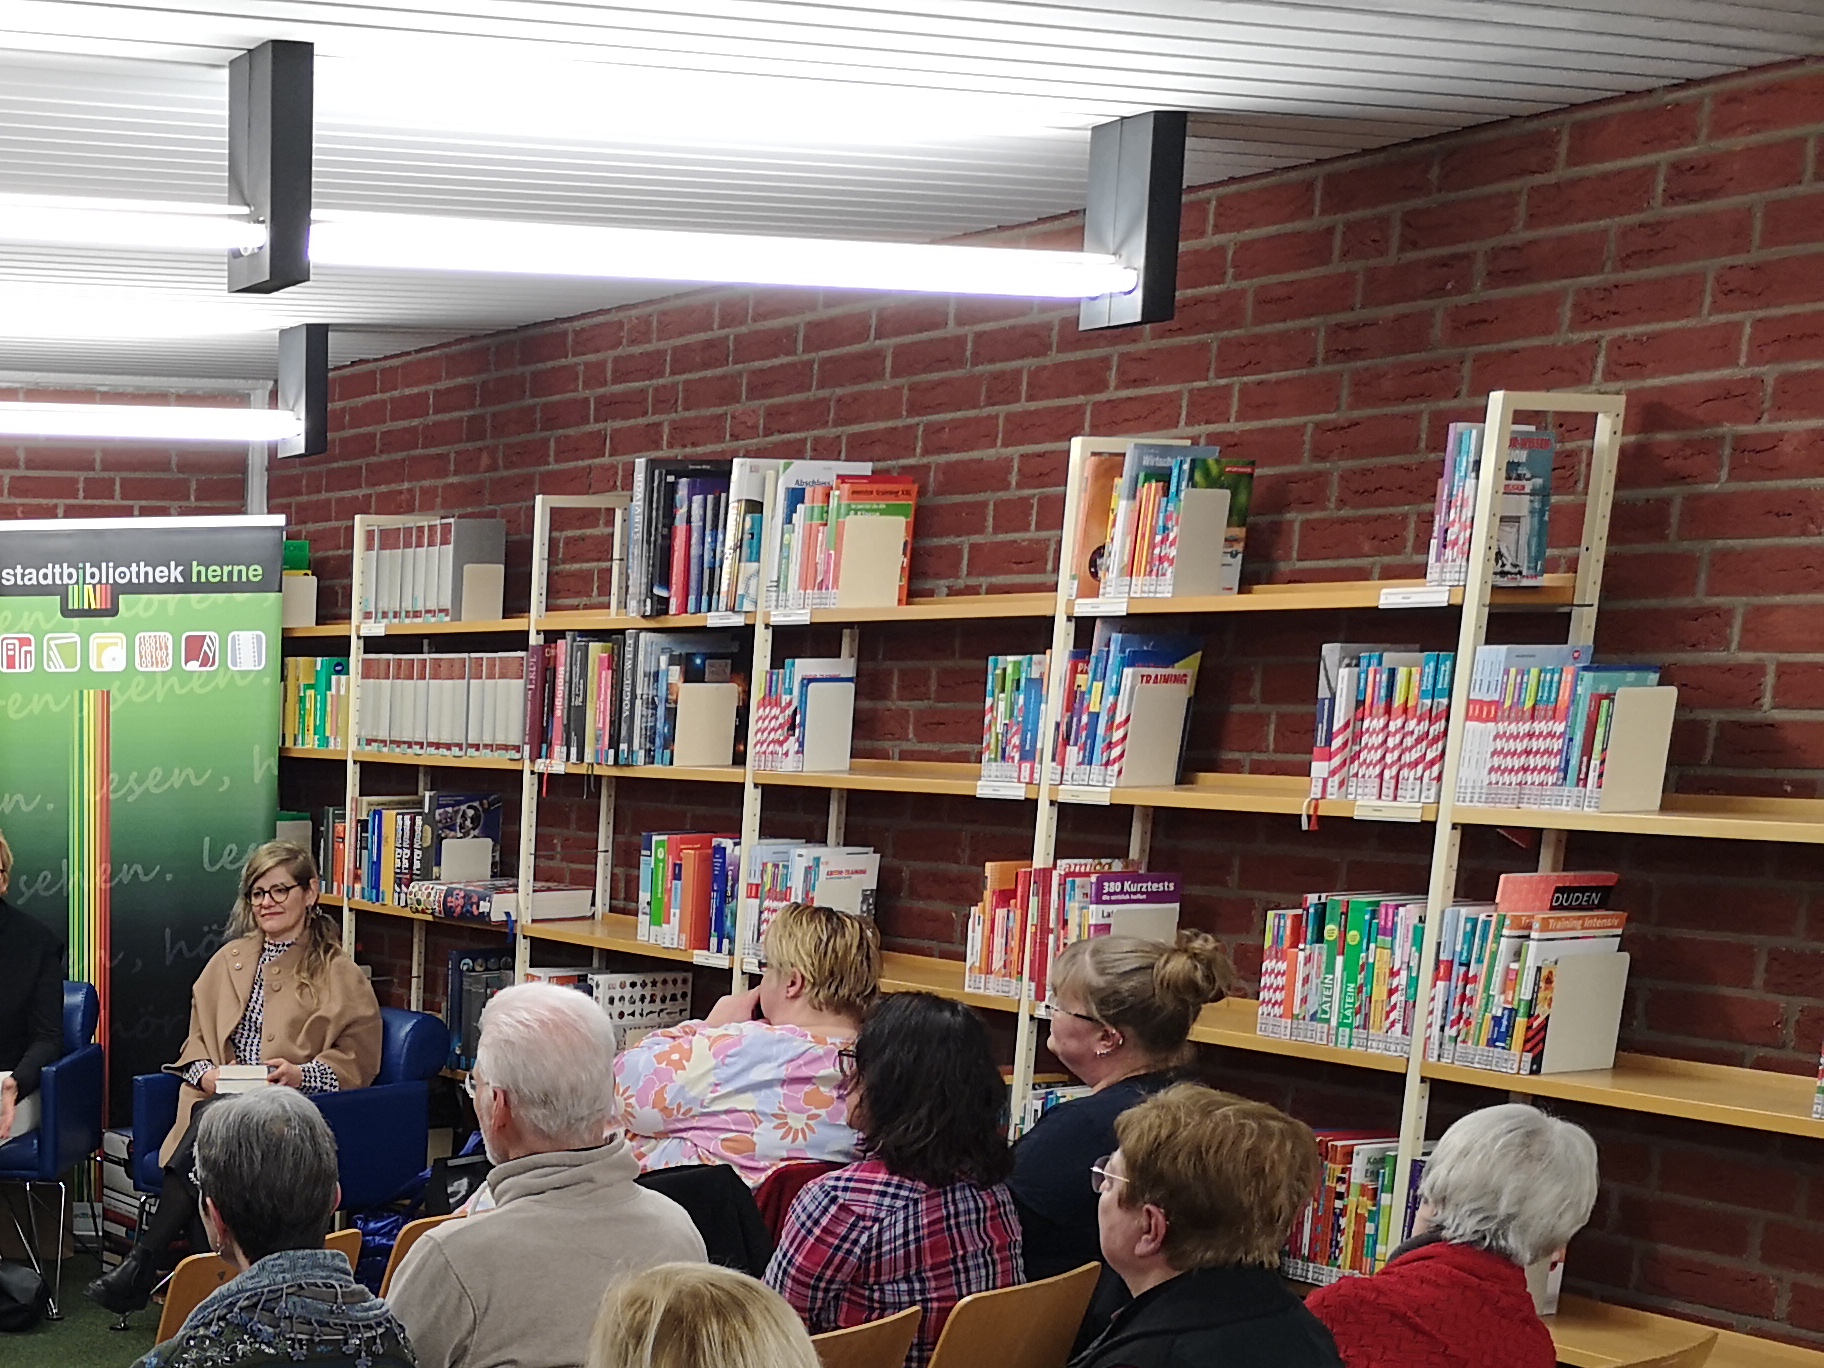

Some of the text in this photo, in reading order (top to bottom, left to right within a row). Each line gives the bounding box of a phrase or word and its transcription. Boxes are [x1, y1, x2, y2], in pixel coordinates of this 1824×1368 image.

[1, 560, 263, 586] stadtbibliothek herne
[1140, 674, 1188, 685] TRAINING
[1102, 880, 1175, 894] 380 Kurztests
[1552, 892, 1602, 907] DUDEN
[1548, 916, 1620, 931] Training Intensiv
[1319, 973, 1334, 1019] LATEIN
[1343, 983, 1356, 1023] LATEIN
